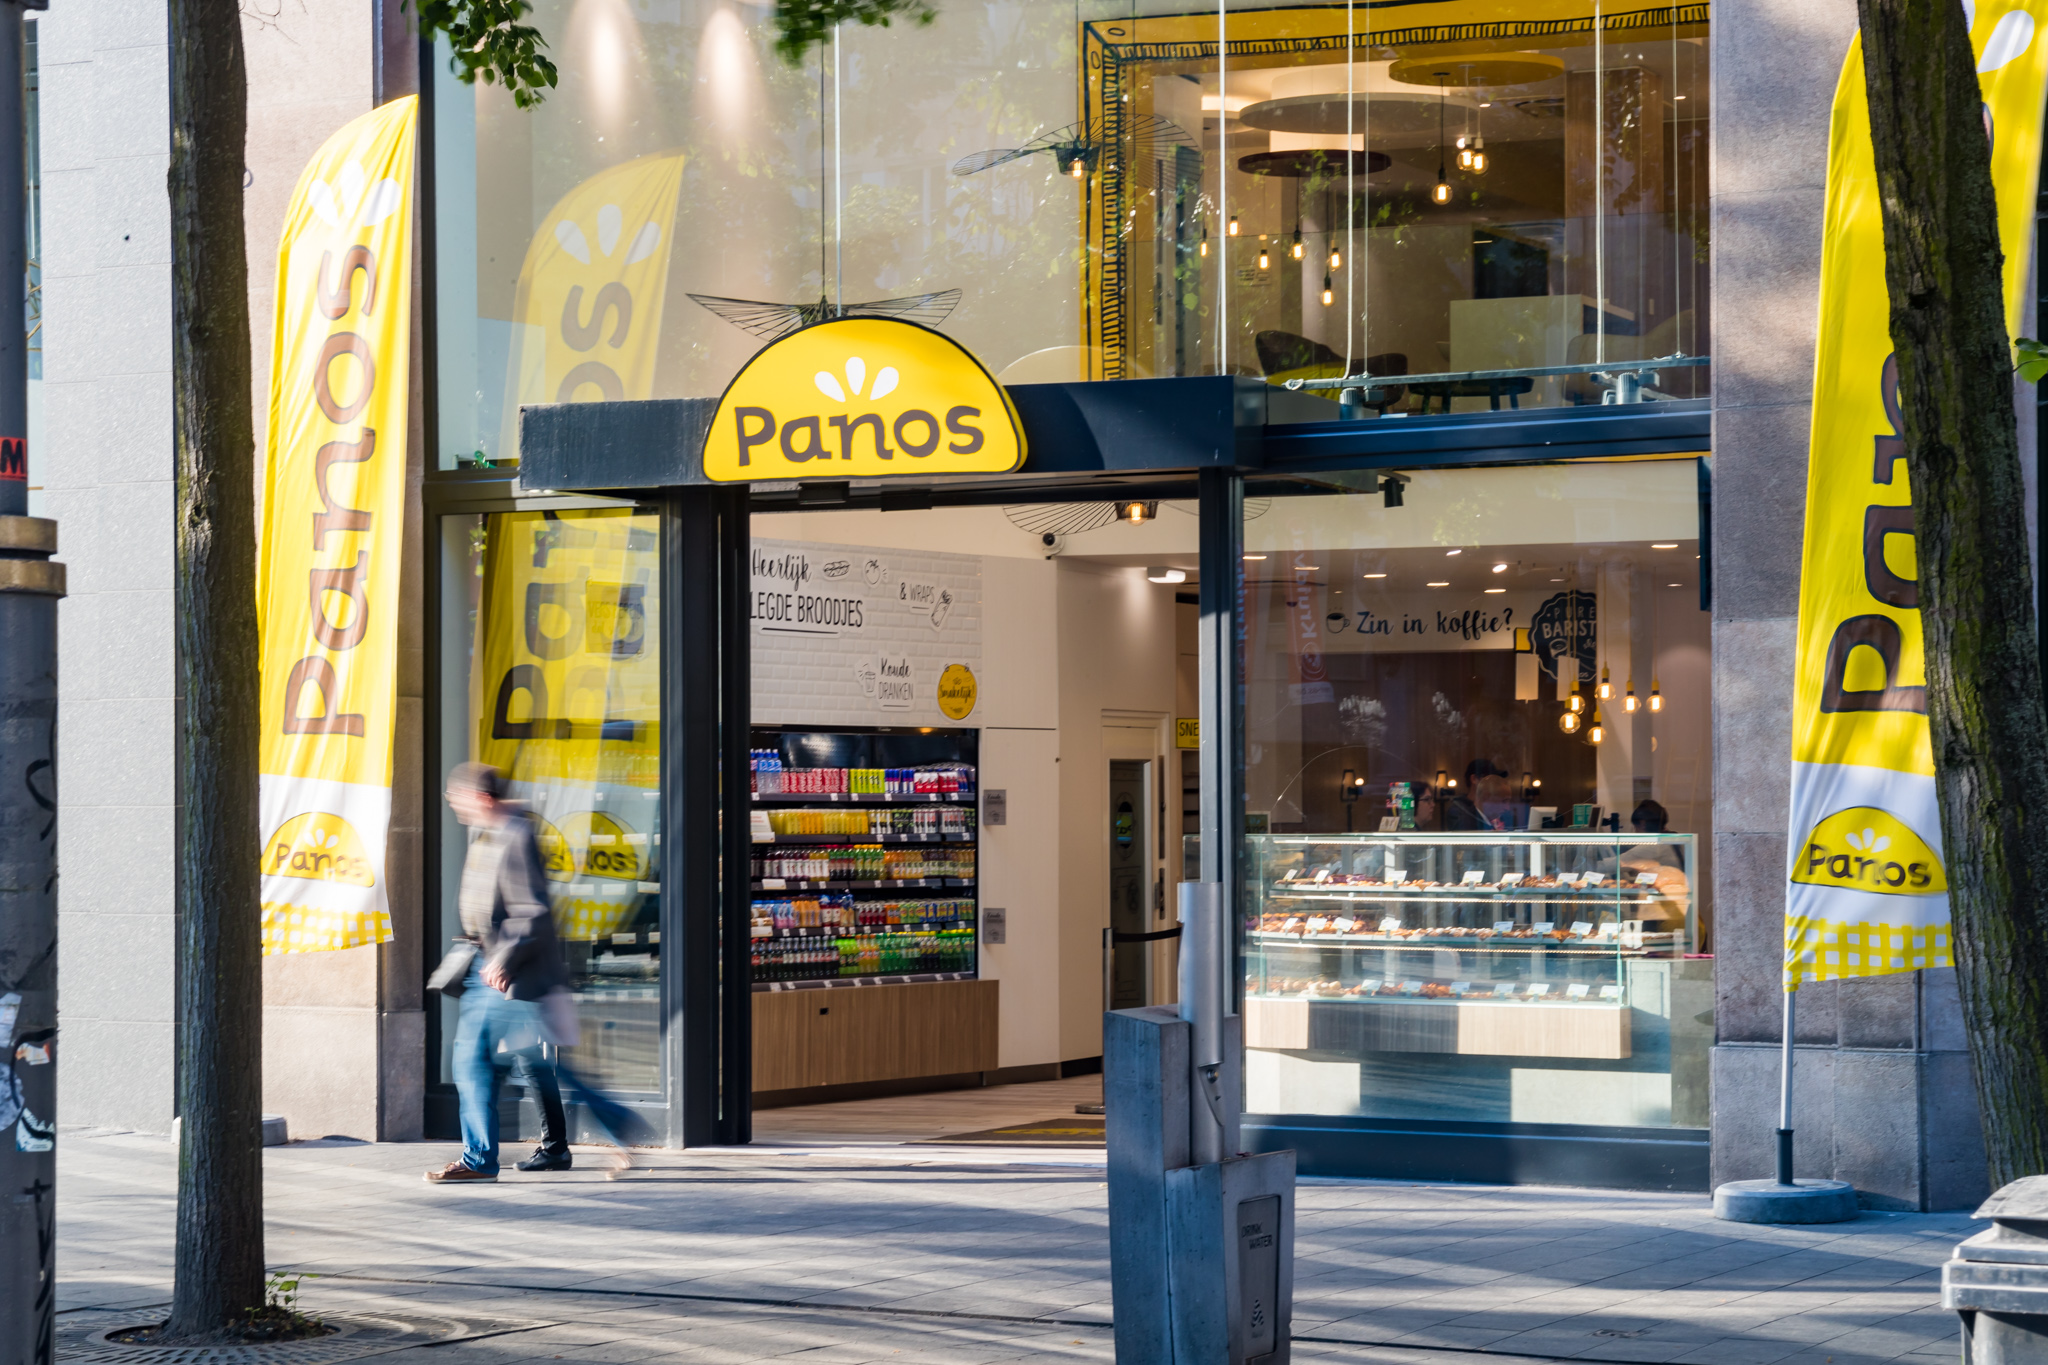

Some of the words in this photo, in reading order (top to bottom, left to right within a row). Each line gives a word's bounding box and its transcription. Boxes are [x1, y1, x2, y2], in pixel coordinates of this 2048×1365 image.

[734, 405, 985, 467] Panos
[283, 244, 377, 738] Panos
[752, 548, 812, 591] Heerlijk
[900, 582, 907, 600] &
[910, 583, 936, 604] WRAPS
[797, 594, 863, 627] BROODJES
[1356, 611, 1394, 635] Zin
[1403, 613, 1428, 635] in
[1436, 607, 1514, 641] koffie?
[1553, 606, 1596, 620] PURE
[880, 657, 912, 678] Koude
[878, 681, 914, 701] DRANKEN
[276, 842, 367, 880] Panos
[1806, 843, 1933, 889] Panos
